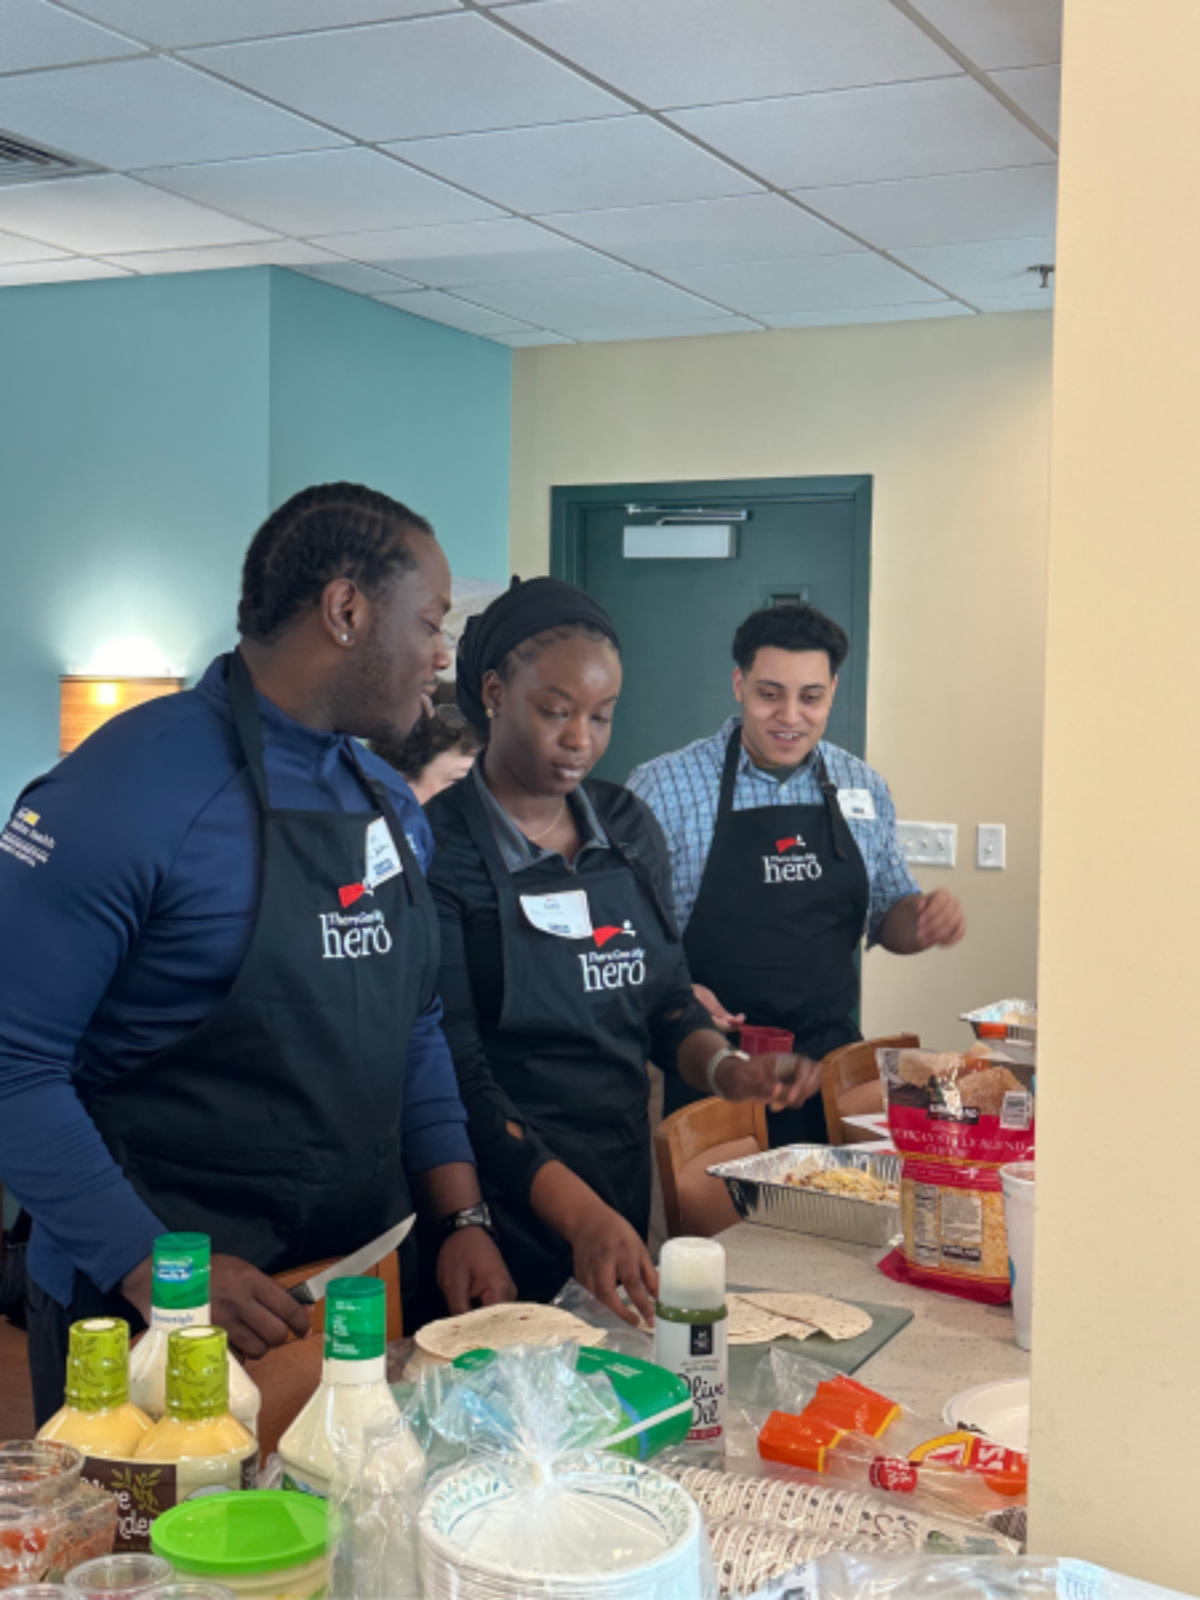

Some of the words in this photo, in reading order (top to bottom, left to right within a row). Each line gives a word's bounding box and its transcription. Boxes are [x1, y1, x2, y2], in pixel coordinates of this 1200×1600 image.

[762, 855, 822, 884] hero
[318, 913, 393, 959] hero
[578, 953, 646, 992] hero
